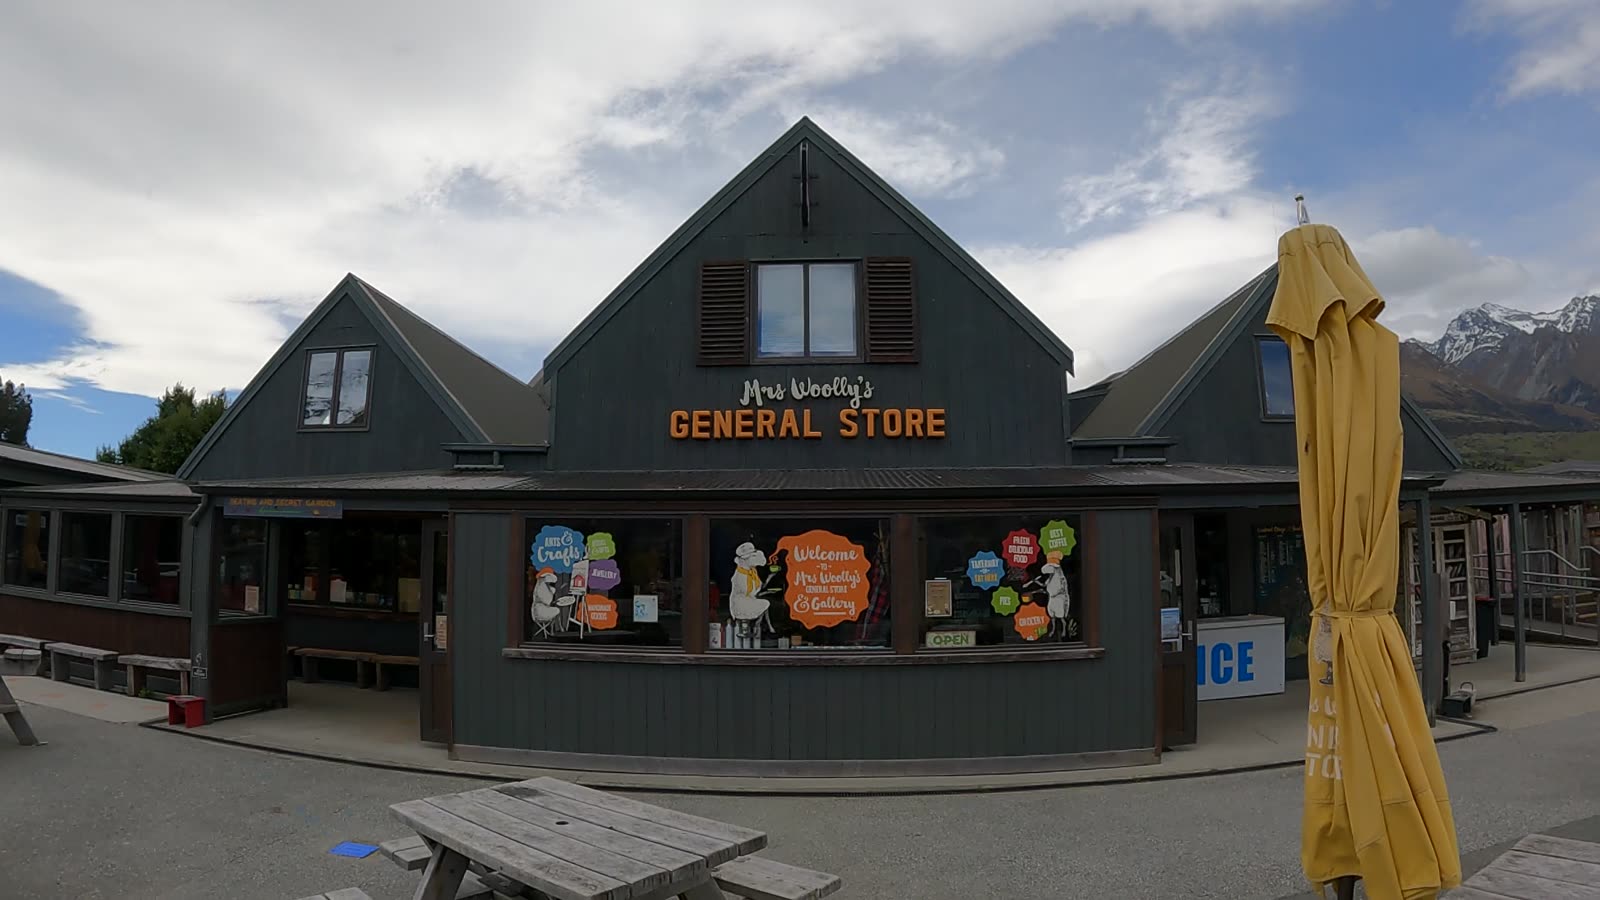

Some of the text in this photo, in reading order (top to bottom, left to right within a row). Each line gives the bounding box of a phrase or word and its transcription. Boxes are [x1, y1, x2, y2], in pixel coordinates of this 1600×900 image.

[740, 376, 874, 409] Mrs Woolly's
[670, 408, 945, 439] GENERAL STORE
[544, 537, 561, 548] ARTS
[537, 546, 580, 567] Crafts
[794, 545, 858, 562] Welcome
[1013, 554, 1028, 564] FOOD
[794, 570, 861, 588] Mrs Woolly's
[793, 594, 855, 615] & Gallery
[933, 633, 969, 645] OPEN
[1196, 641, 1254, 686] ICE
